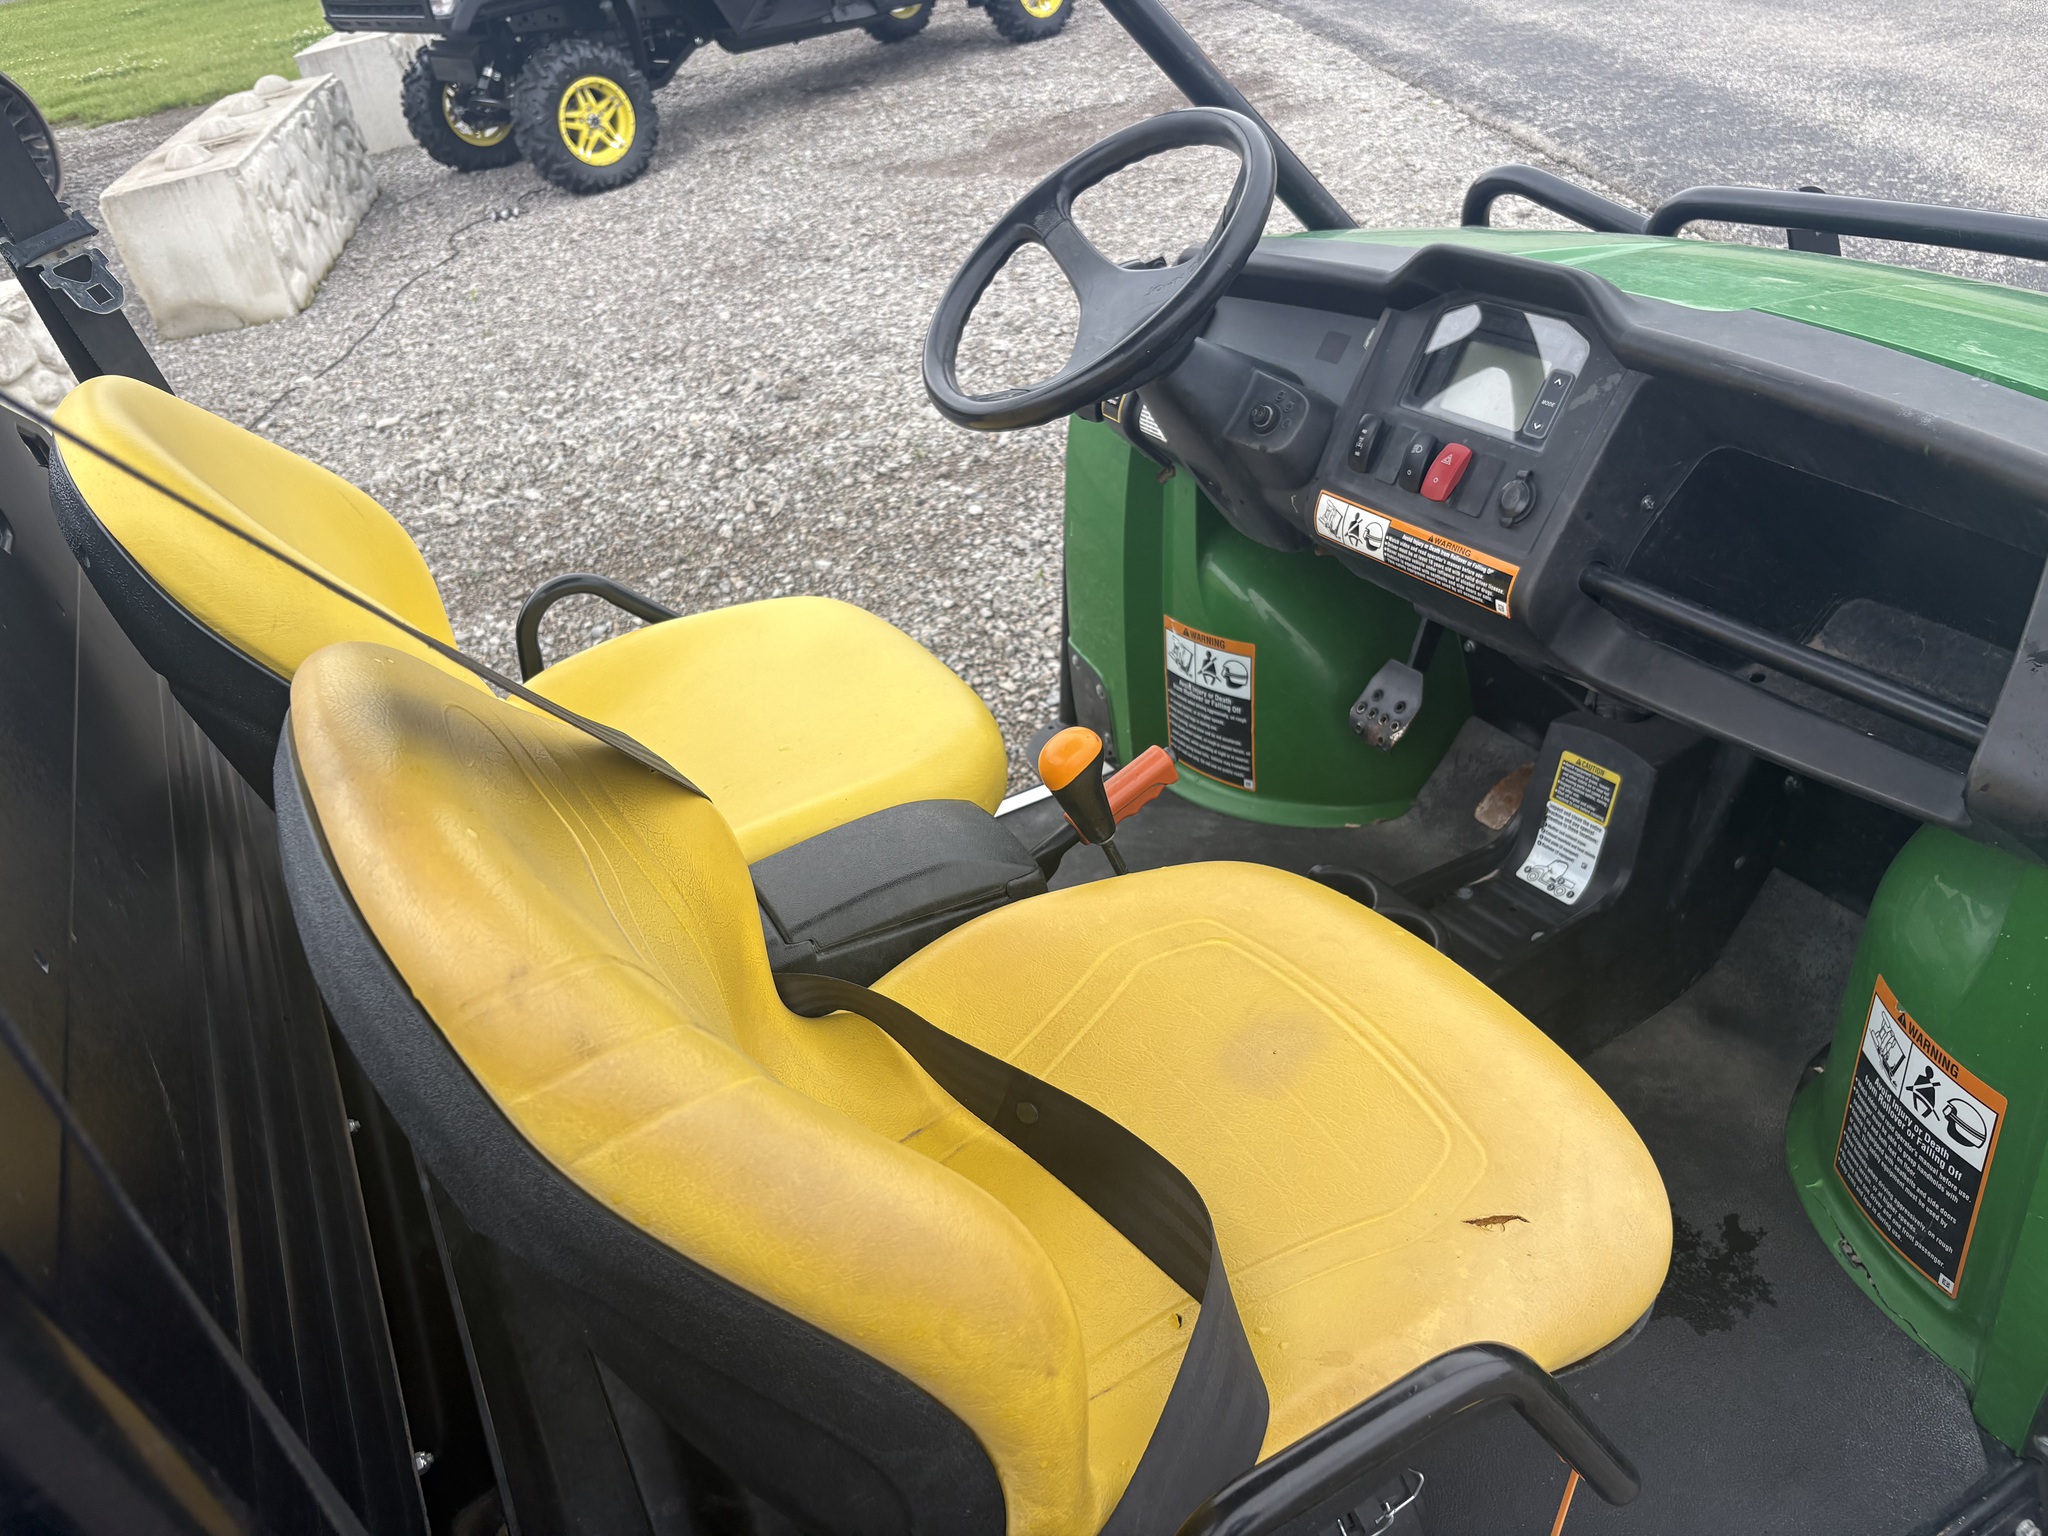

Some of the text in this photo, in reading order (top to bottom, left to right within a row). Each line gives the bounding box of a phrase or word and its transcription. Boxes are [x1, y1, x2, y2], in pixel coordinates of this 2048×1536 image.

[1541, 399, 1556, 408] MODE
[1435, 537, 1472, 557] WARNING
[1191, 631, 1226, 650] WARNING
[1581, 760, 1605, 777] CAUTION
[1908, 1021, 1960, 1079] WARNING
[1864, 1074, 1962, 1180] from Rollover or Falling Off
[1874, 1076, 1949, 1160] Avoid Injury or Death
